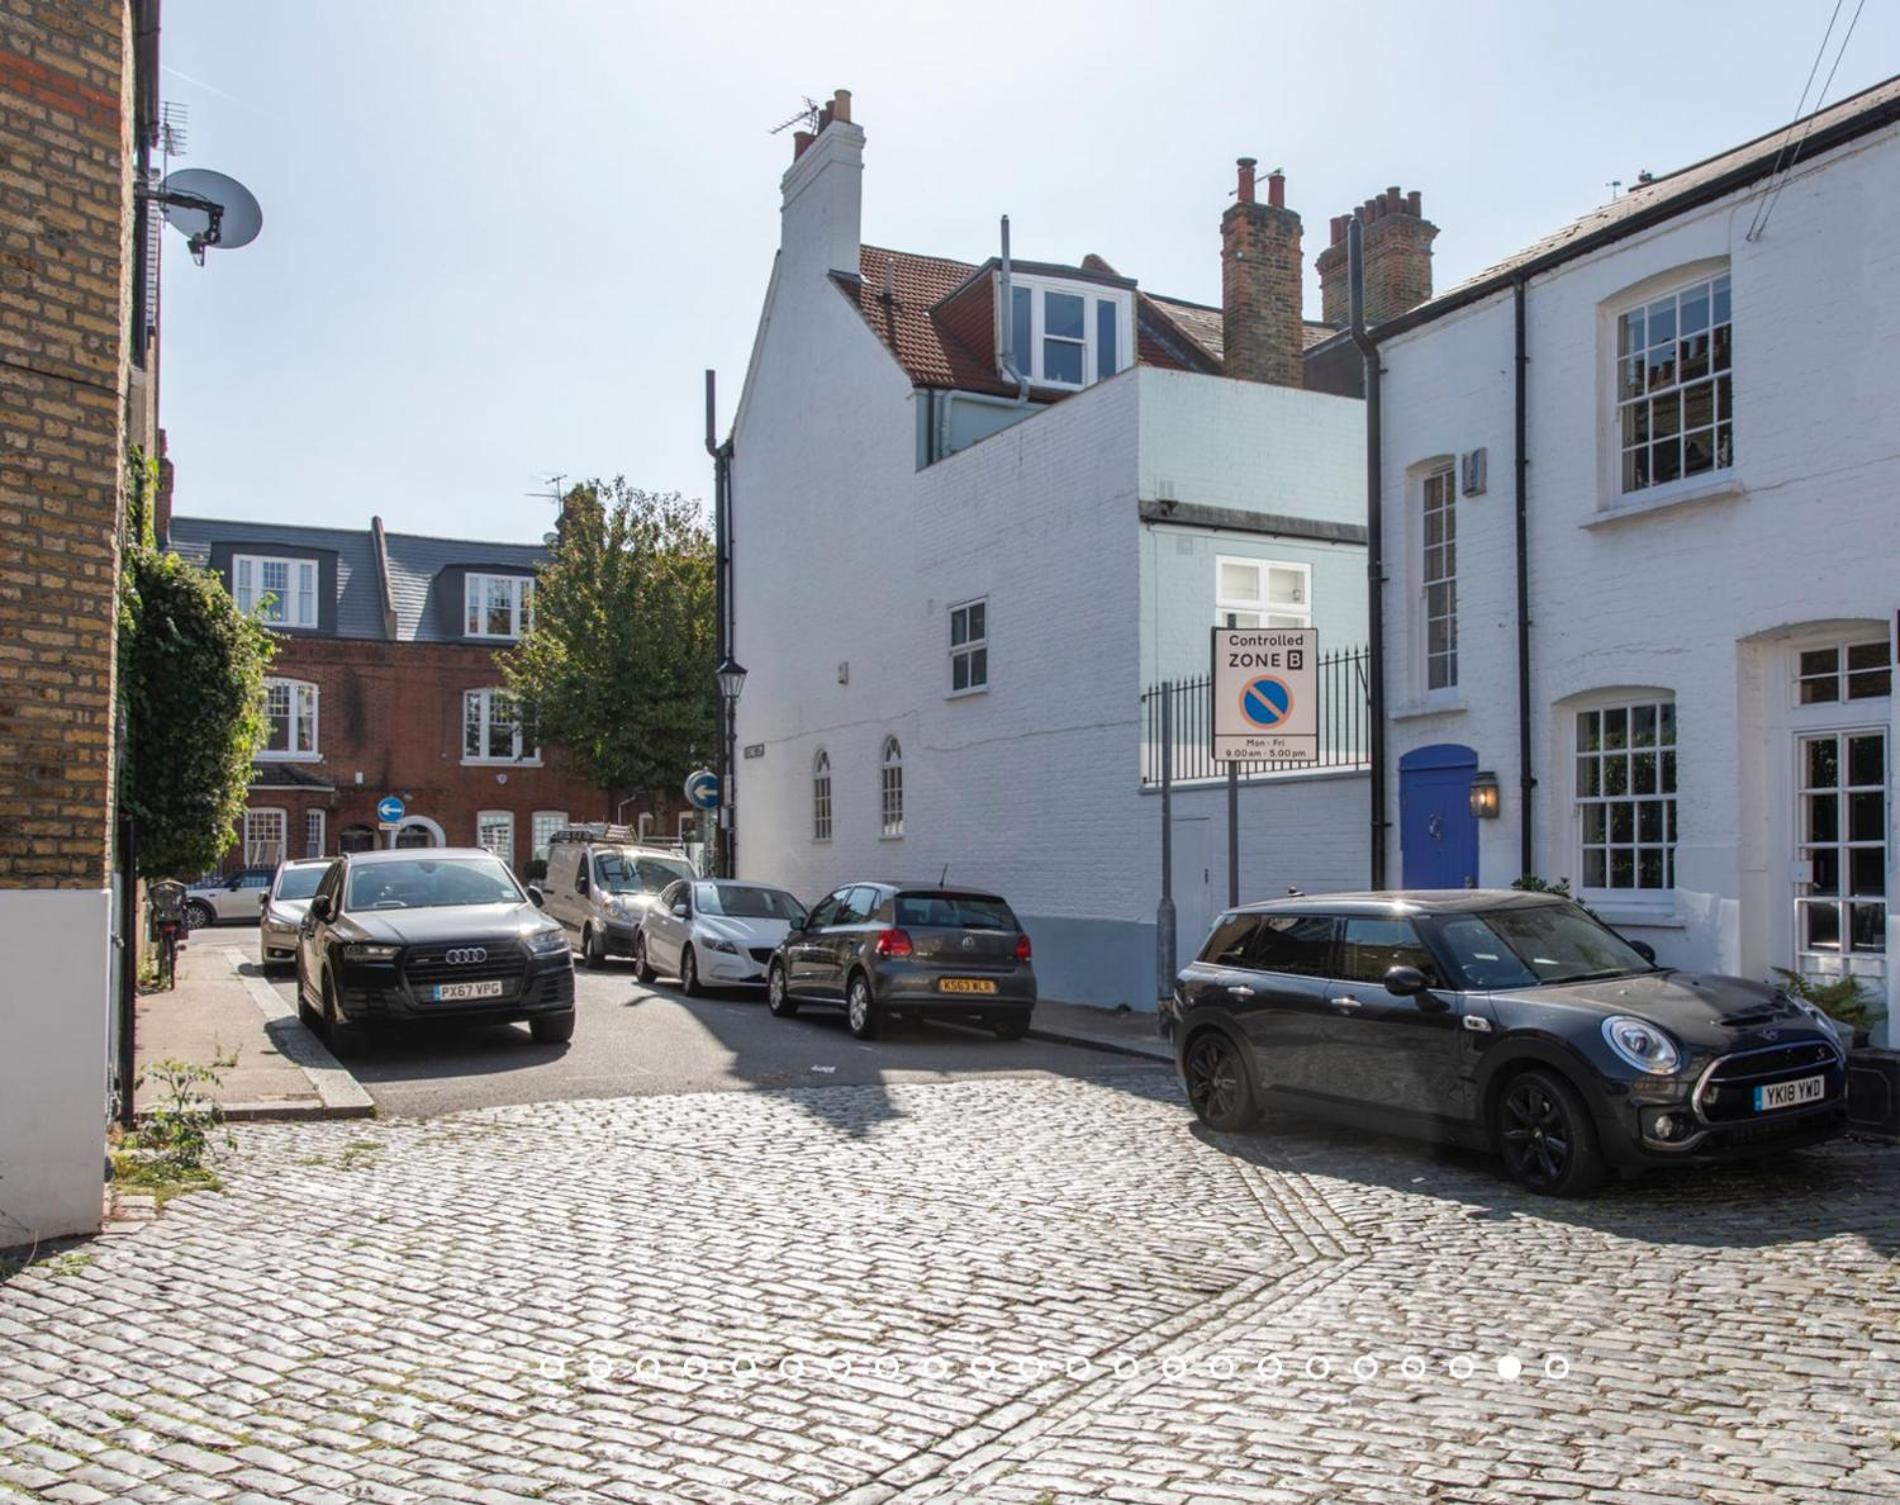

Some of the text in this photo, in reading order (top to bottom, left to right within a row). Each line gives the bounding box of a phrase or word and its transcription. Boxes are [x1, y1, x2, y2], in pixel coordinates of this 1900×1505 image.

[1229, 634, 1304, 647] Controlled
[1229, 653, 1281, 667] ZONE
[1246, 739, 1265, 747] Mon
[1272, 739, 1285, 747] Fri
[1292, 750, 1306, 758] pm
[442, 983, 500, 997] PX67 VPG
[1767, 1079, 1820, 1105] YK18 YWD
